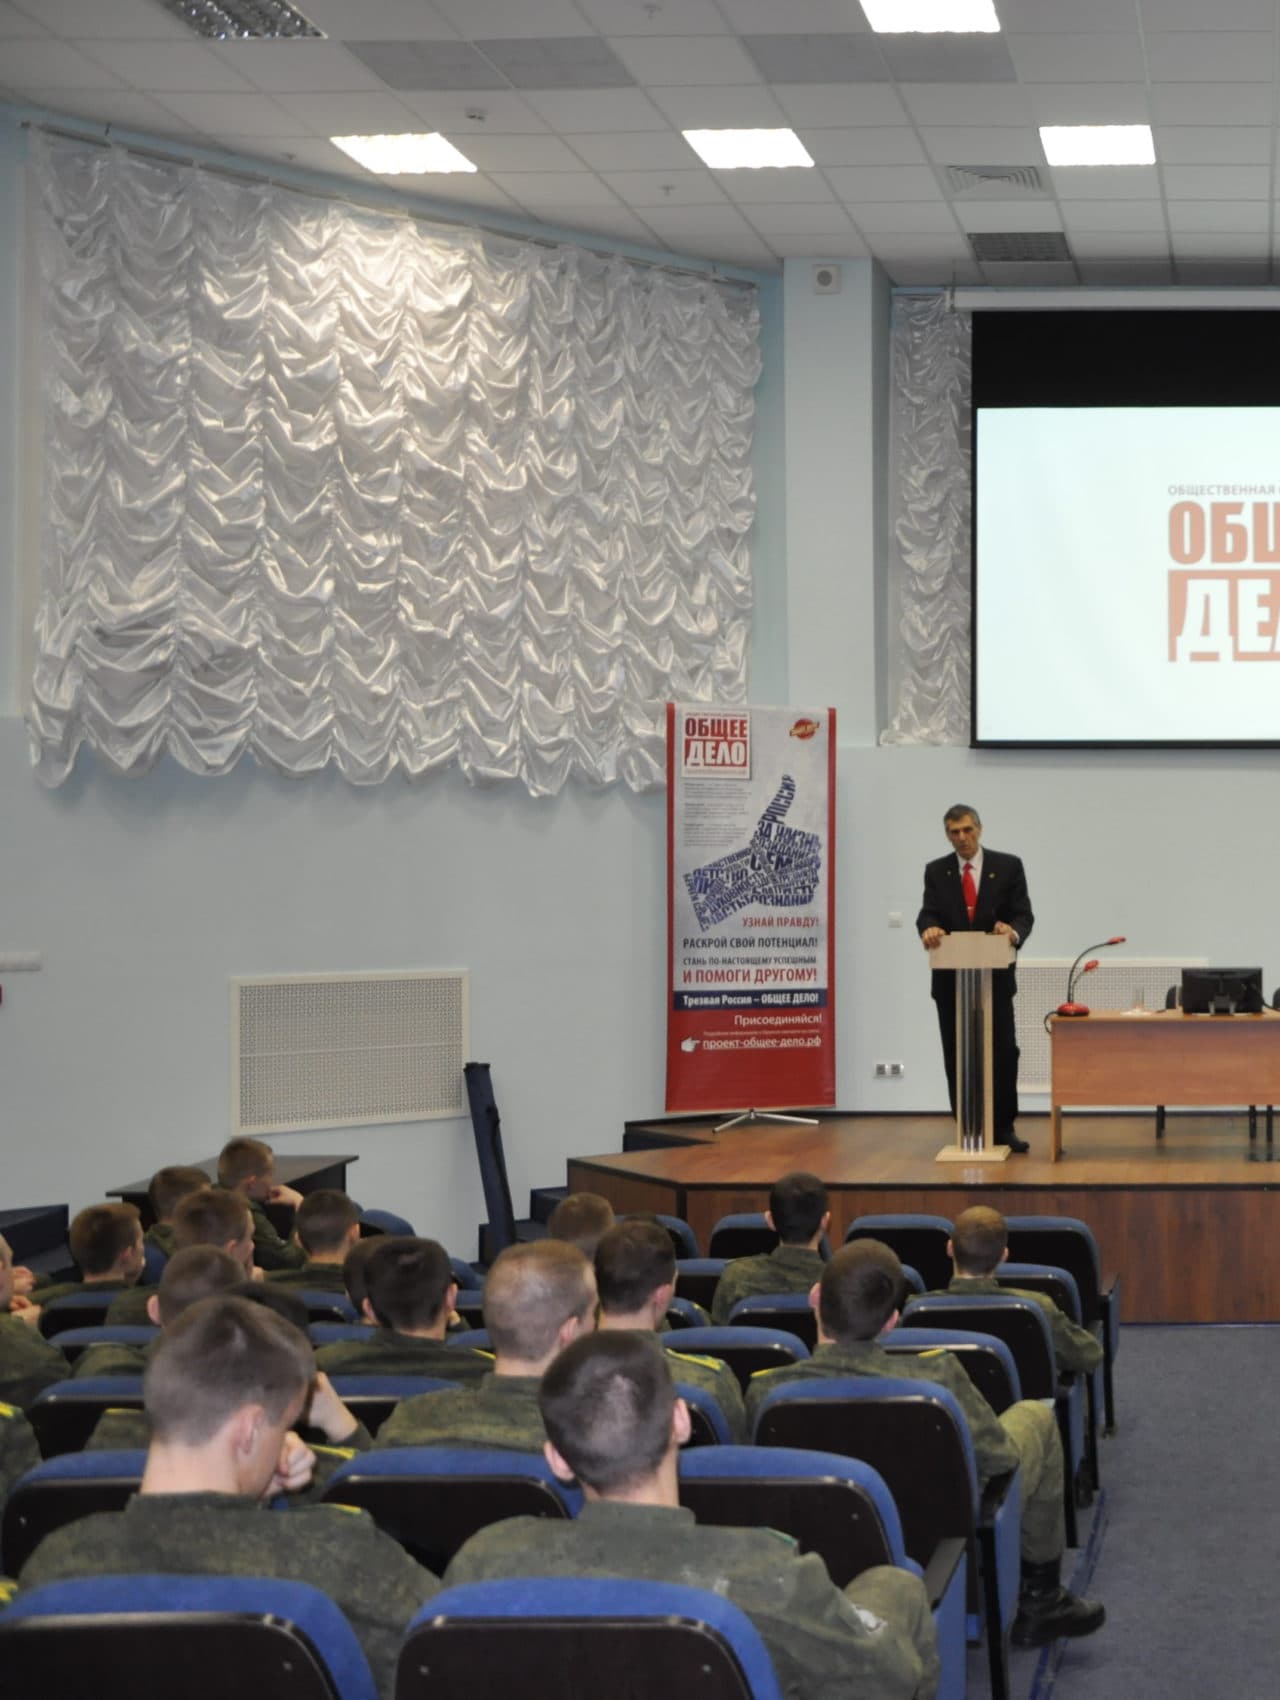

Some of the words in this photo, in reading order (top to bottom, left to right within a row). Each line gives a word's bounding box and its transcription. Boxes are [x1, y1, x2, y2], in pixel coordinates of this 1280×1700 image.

[1168, 484, 1275, 497] ОБЩЕСТВЕННАЯ
[685, 718, 748, 740] ОБЩЕЕ
[686, 741, 747, 767] ДЕЛО
[742, 916, 774, 928] УЗНАЙ
[777, 917, 819, 929] ПРАВДУ!
[683, 936, 727, 949] РАСКРОЙ
[730, 936, 755, 948] СВОЙ
[758, 936, 818, 949] ПОТЕНЦИАЛ!
[683, 957, 707, 966] СТАНЬ
[683, 970, 692, 983] И
[695, 968, 750, 983] ПОМОГИ
[754, 968, 817, 984] ДРУГОМУ!
[722, 994, 751, 1005] Россия
[761, 993, 791, 1005] ОБЩЕЕ
[792, 993, 819, 1005] ДЕЛО!
[734, 1013, 823, 1027] Присоединяйся!
[702, 1034, 822, 1050] проект-общее-дело.рф
